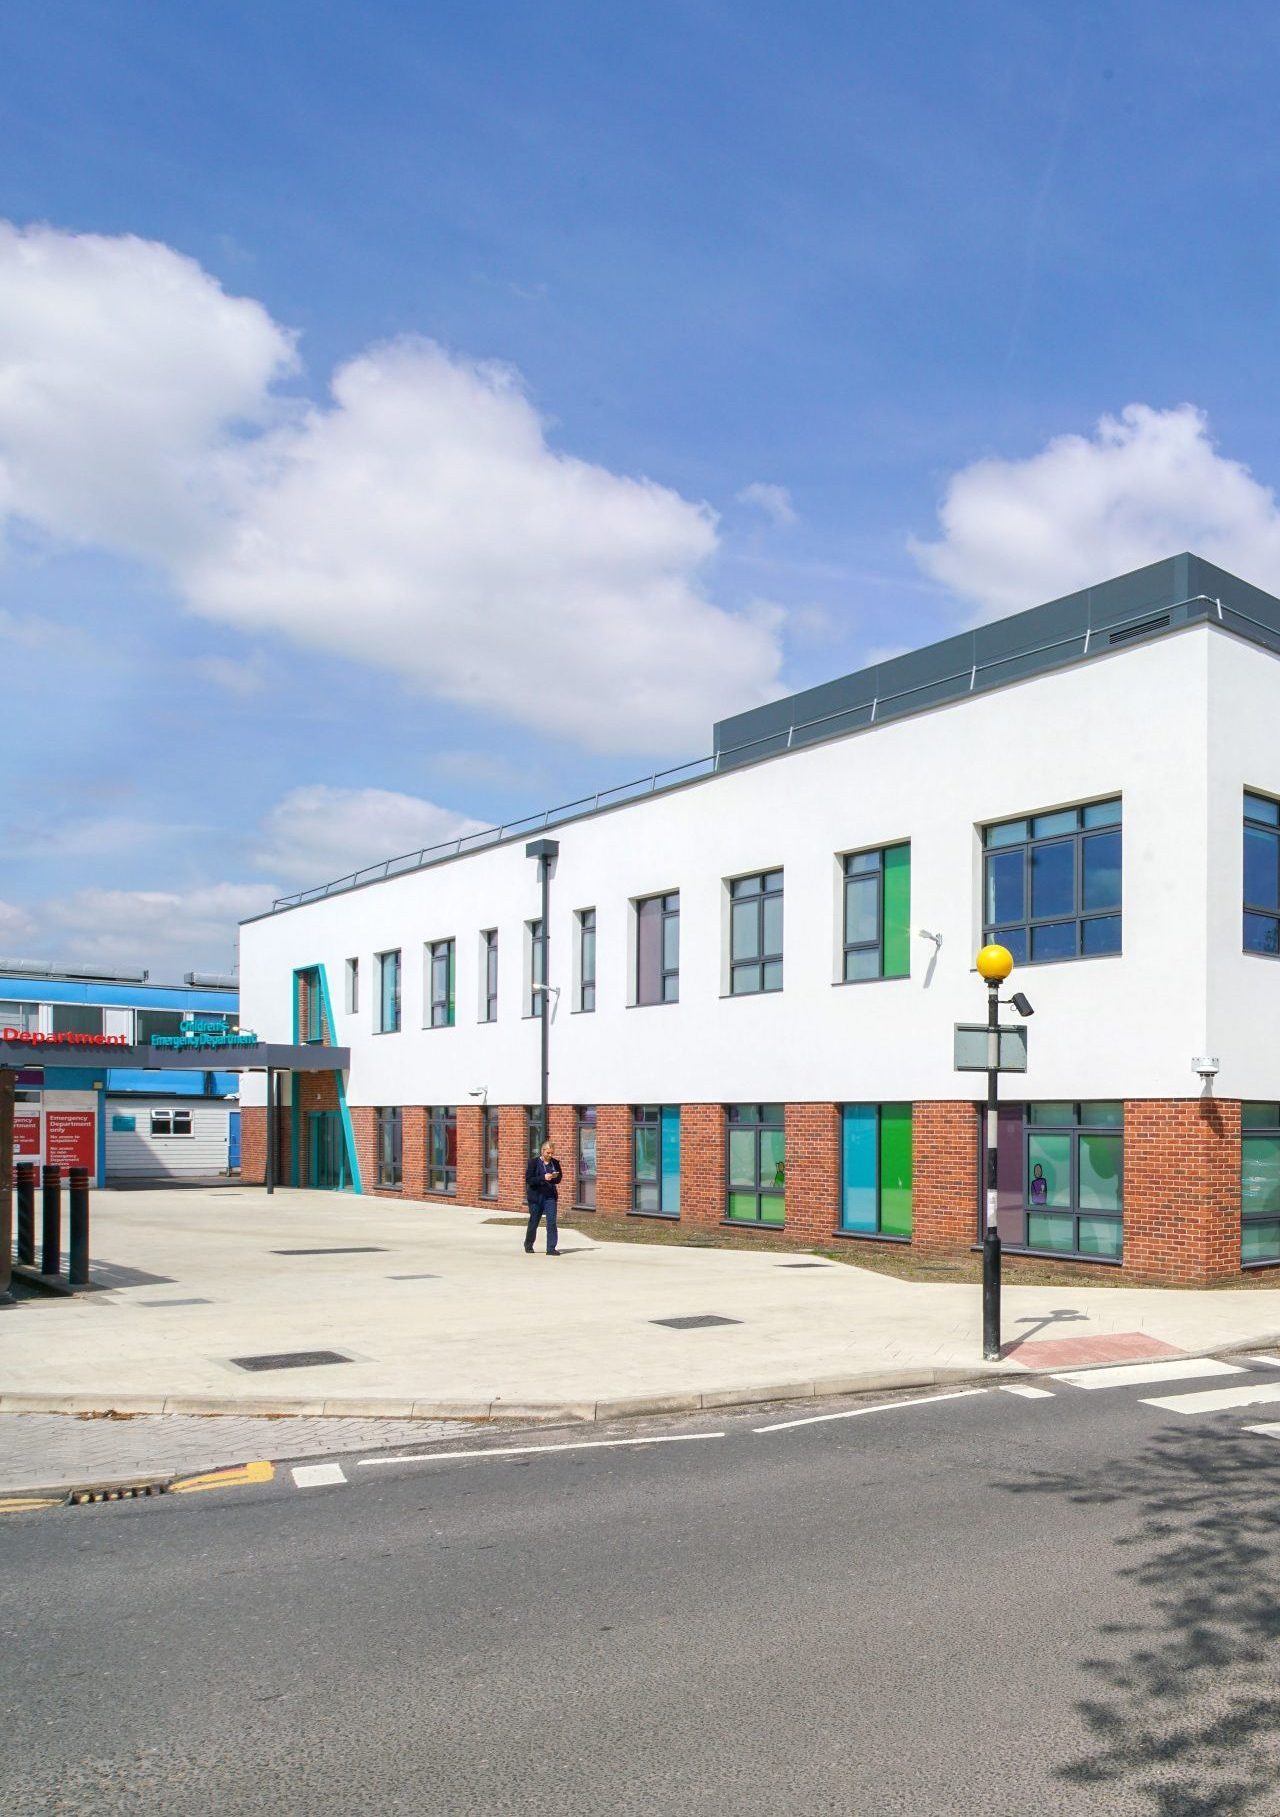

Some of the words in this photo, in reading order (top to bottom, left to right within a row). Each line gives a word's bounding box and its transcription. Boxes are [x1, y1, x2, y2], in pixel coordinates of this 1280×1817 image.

[180, 1020, 229, 1033] Children's
[3, 1027, 127, 1047] Department
[151, 1034, 199, 1049] Emergency
[200, 1033, 257, 1048] Department
